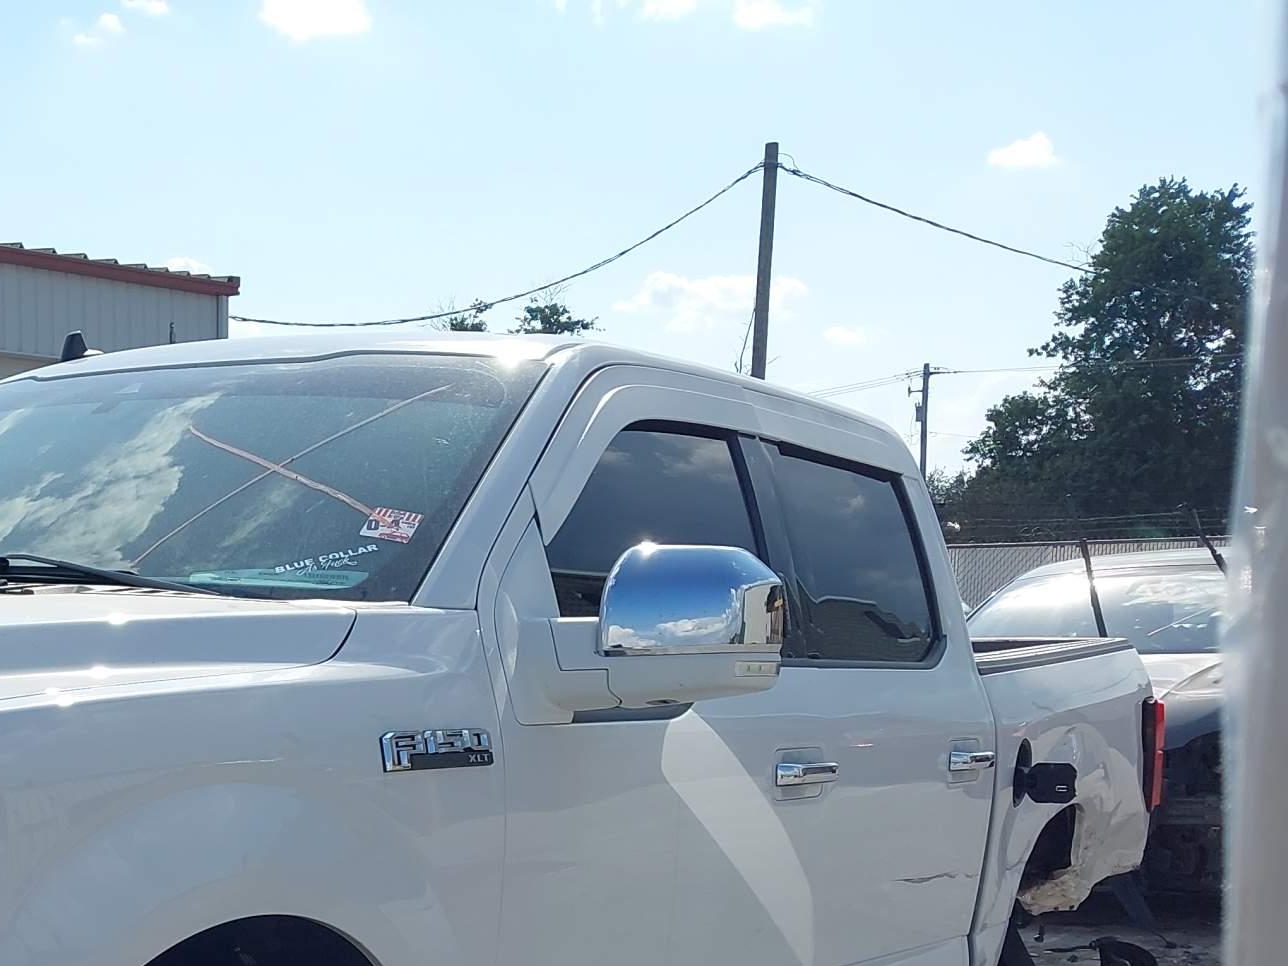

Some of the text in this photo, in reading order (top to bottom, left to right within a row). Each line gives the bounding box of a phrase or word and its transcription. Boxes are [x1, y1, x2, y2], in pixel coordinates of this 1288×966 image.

[274, 544, 379, 574] BLUE COLLAR
[468, 753, 490, 763] XLT
